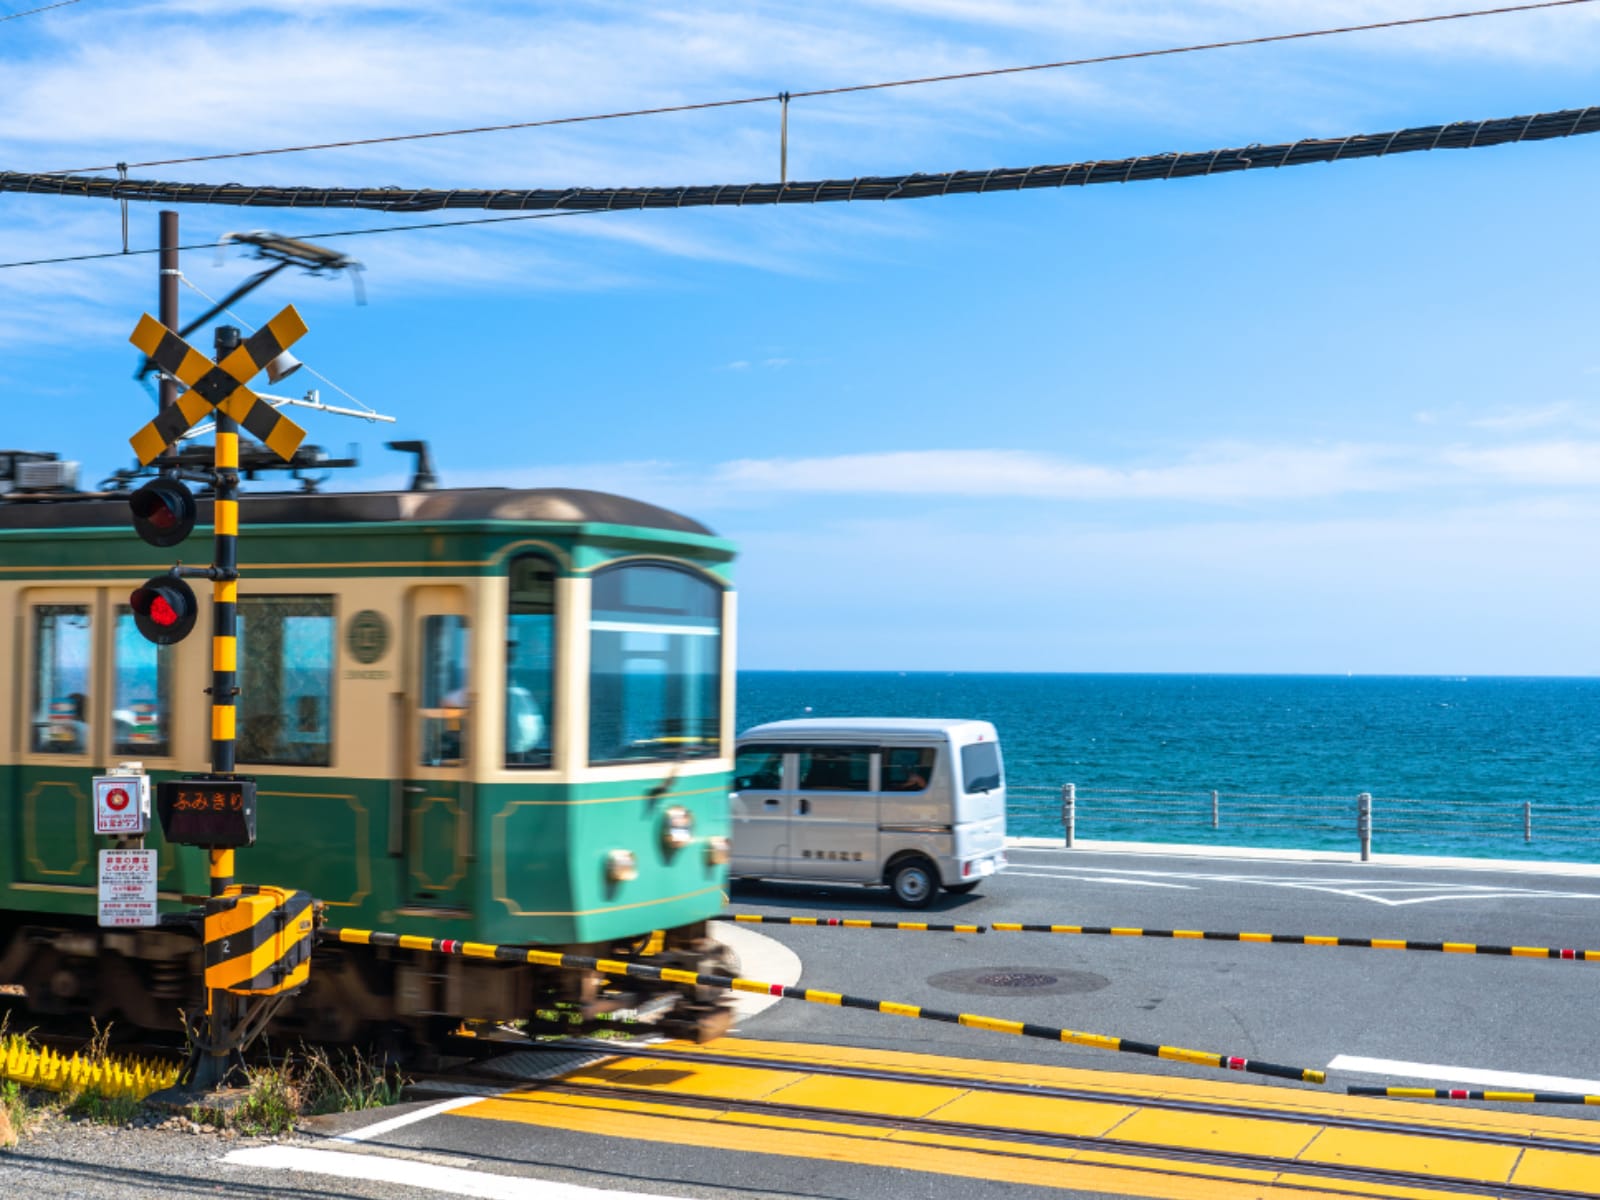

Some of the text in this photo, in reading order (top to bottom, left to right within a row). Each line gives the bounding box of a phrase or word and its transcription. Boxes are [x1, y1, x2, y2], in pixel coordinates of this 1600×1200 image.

[172, 791, 243, 811] ふみきり
[223, 940, 231, 953] 2
